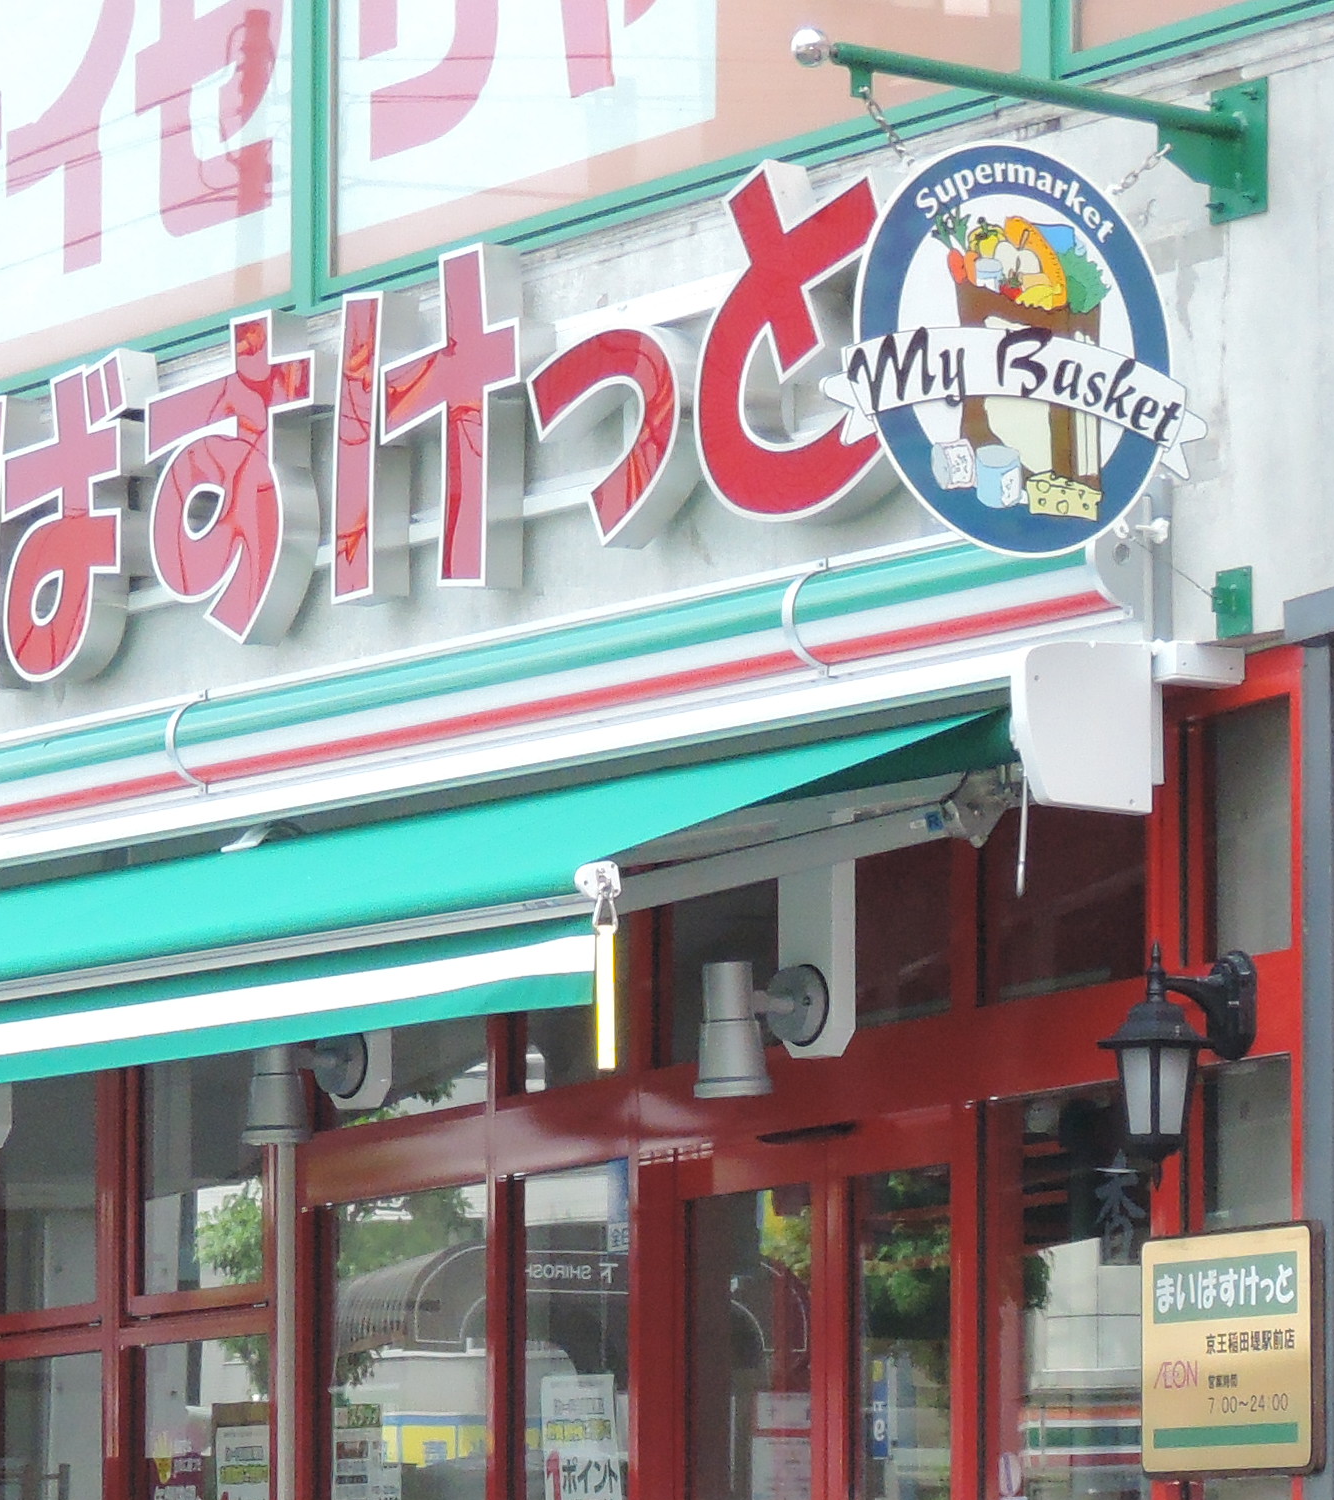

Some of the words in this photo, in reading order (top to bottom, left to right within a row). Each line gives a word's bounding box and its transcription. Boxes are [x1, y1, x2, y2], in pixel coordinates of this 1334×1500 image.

[916, 161, 1114, 243] Supermarket
[848, 327, 966, 412] My
[998, 328, 1181, 443] Basket
[1156, 1264, 1295, 1313] まいばすけっと
[1205, 1328, 1295, 1354] 京王稲田堤駅前店
[562, 1458, 618, 1495] ポイント
